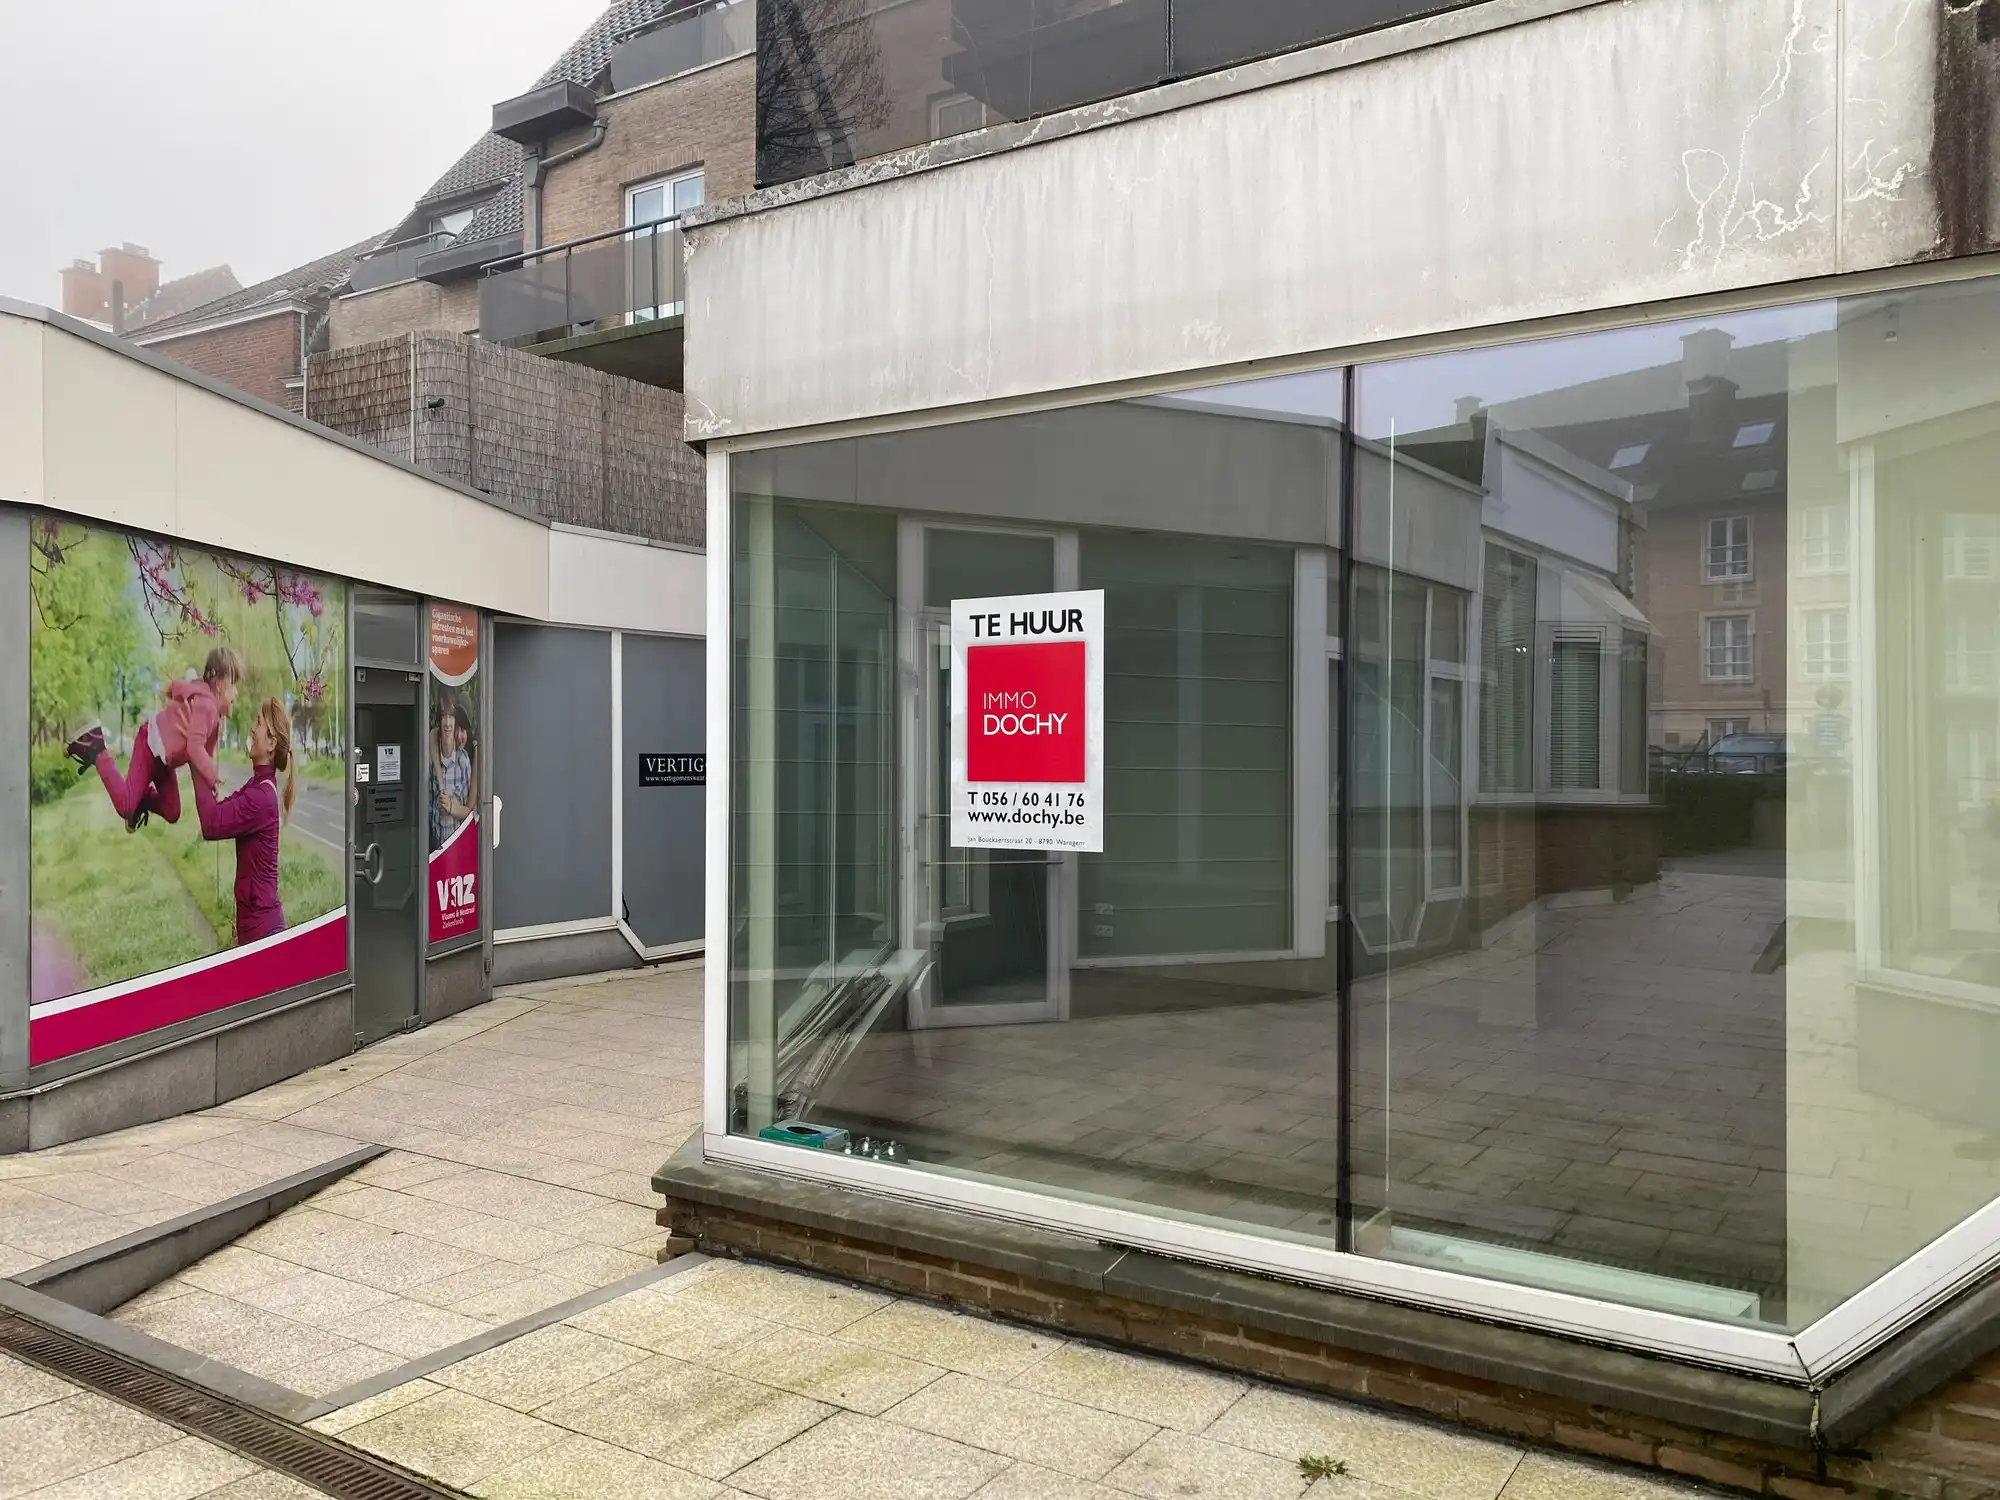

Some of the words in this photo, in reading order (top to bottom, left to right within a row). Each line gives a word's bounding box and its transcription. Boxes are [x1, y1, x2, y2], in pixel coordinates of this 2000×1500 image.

[969, 613, 1001, 638] TE
[1010, 608, 1084, 635] HUUR
[983, 690, 1037, 710] IMMO
[983, 712, 1068, 736] DOCHY
[646, 757, 705, 773] VERTIG
[645, 775, 705, 783] www.vertigomenswear
[968, 791, 978, 805] T
[983, 791, 1008, 806] 056
[1012, 791, 1018, 806] /
[1022, 791, 1039, 807] 60
[1044, 792, 1060, 807] 41
[1067, 793, 1085, 808] 76
[968, 807, 1085, 828] www.dochy.be
[967, 836, 976, 844] Jan
